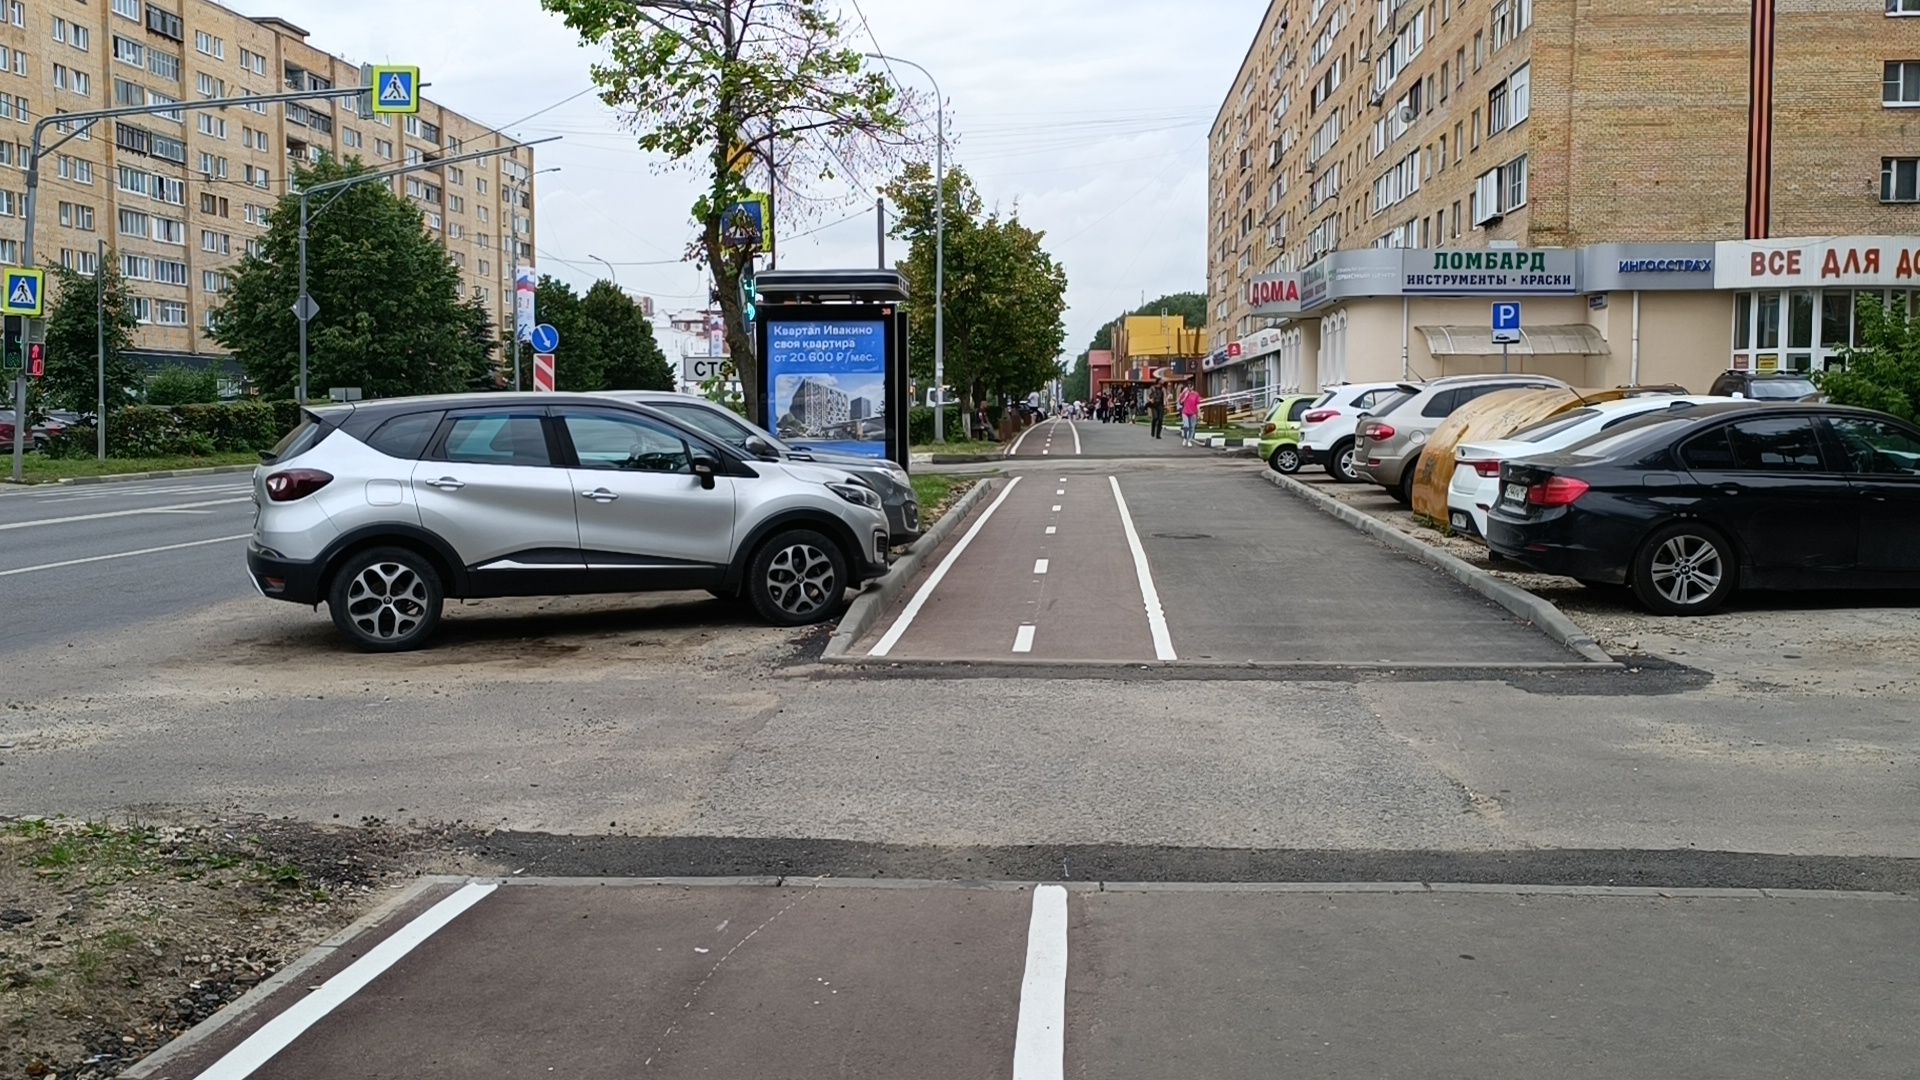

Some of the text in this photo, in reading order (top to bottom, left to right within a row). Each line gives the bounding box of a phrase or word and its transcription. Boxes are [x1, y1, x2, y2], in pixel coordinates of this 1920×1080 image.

[1433, 252, 1546, 272] ЛОМБАРД
[1618, 258, 1712, 273] ИНГОССТРАХ
[1750, 250, 1802, 276] ВСЕ
[1821, 248, 1880, 279] ДЛЯ
[1406, 274, 1571, 287] ИНСТРУМЕНТЫ КРАСКИ
[1249, 280, 1299, 307] ДОМА
[1499, 305, 1515, 327] P
[774, 325, 873, 337] Квартал Ивакино
[803, 342, 856, 350] квартира
[790, 353, 805, 363] 20
[809, 353, 834, 363] 600
[694, 361, 736, 377] СТ
